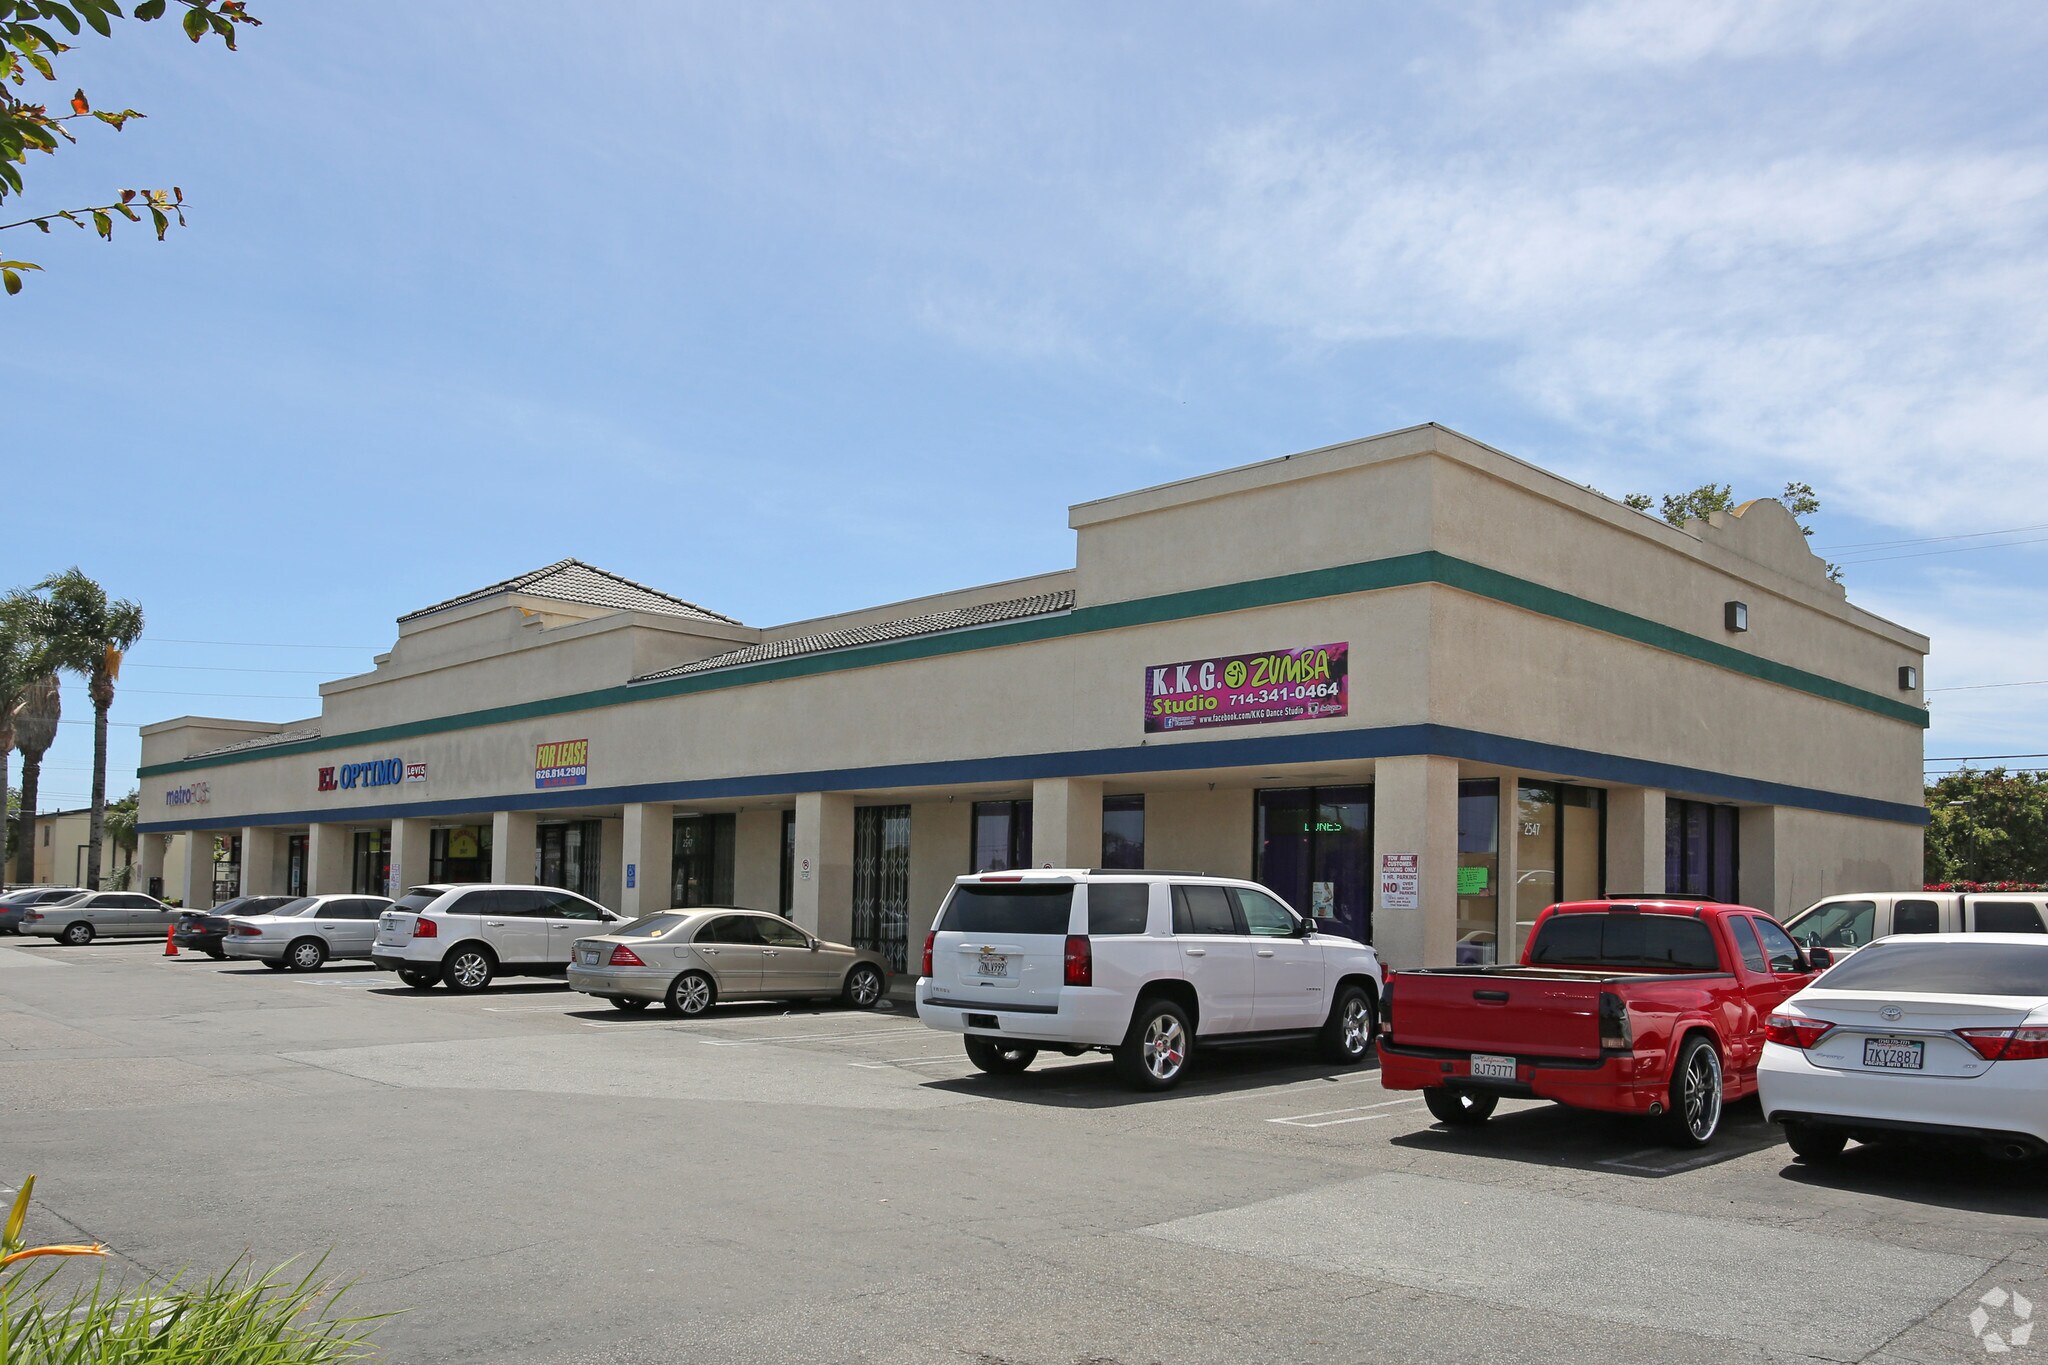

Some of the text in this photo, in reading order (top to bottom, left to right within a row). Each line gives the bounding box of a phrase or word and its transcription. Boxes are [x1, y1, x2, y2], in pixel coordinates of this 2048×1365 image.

[1153, 649, 1329, 696] K.K.G. ZUMBA
[1229, 682, 1339, 706] 714-341-0464
[1152, 695, 1218, 715] Studio
[1266, 708, 1283, 717] Dance
[1285, 706, 1304, 715] Studio
[536, 745, 556, 769] FOR
[557, 741, 588, 767] LEASE
[318, 758, 403, 791] EL OPTIMO
[535, 766, 586, 779] 626.814.2900
[1524, 822, 1540, 836] 2547
[1383, 883, 1397, 893] NO
[1868, 1048, 1919, 1064] 7KYZ887
[1474, 1063, 1513, 1077] 8J73777
